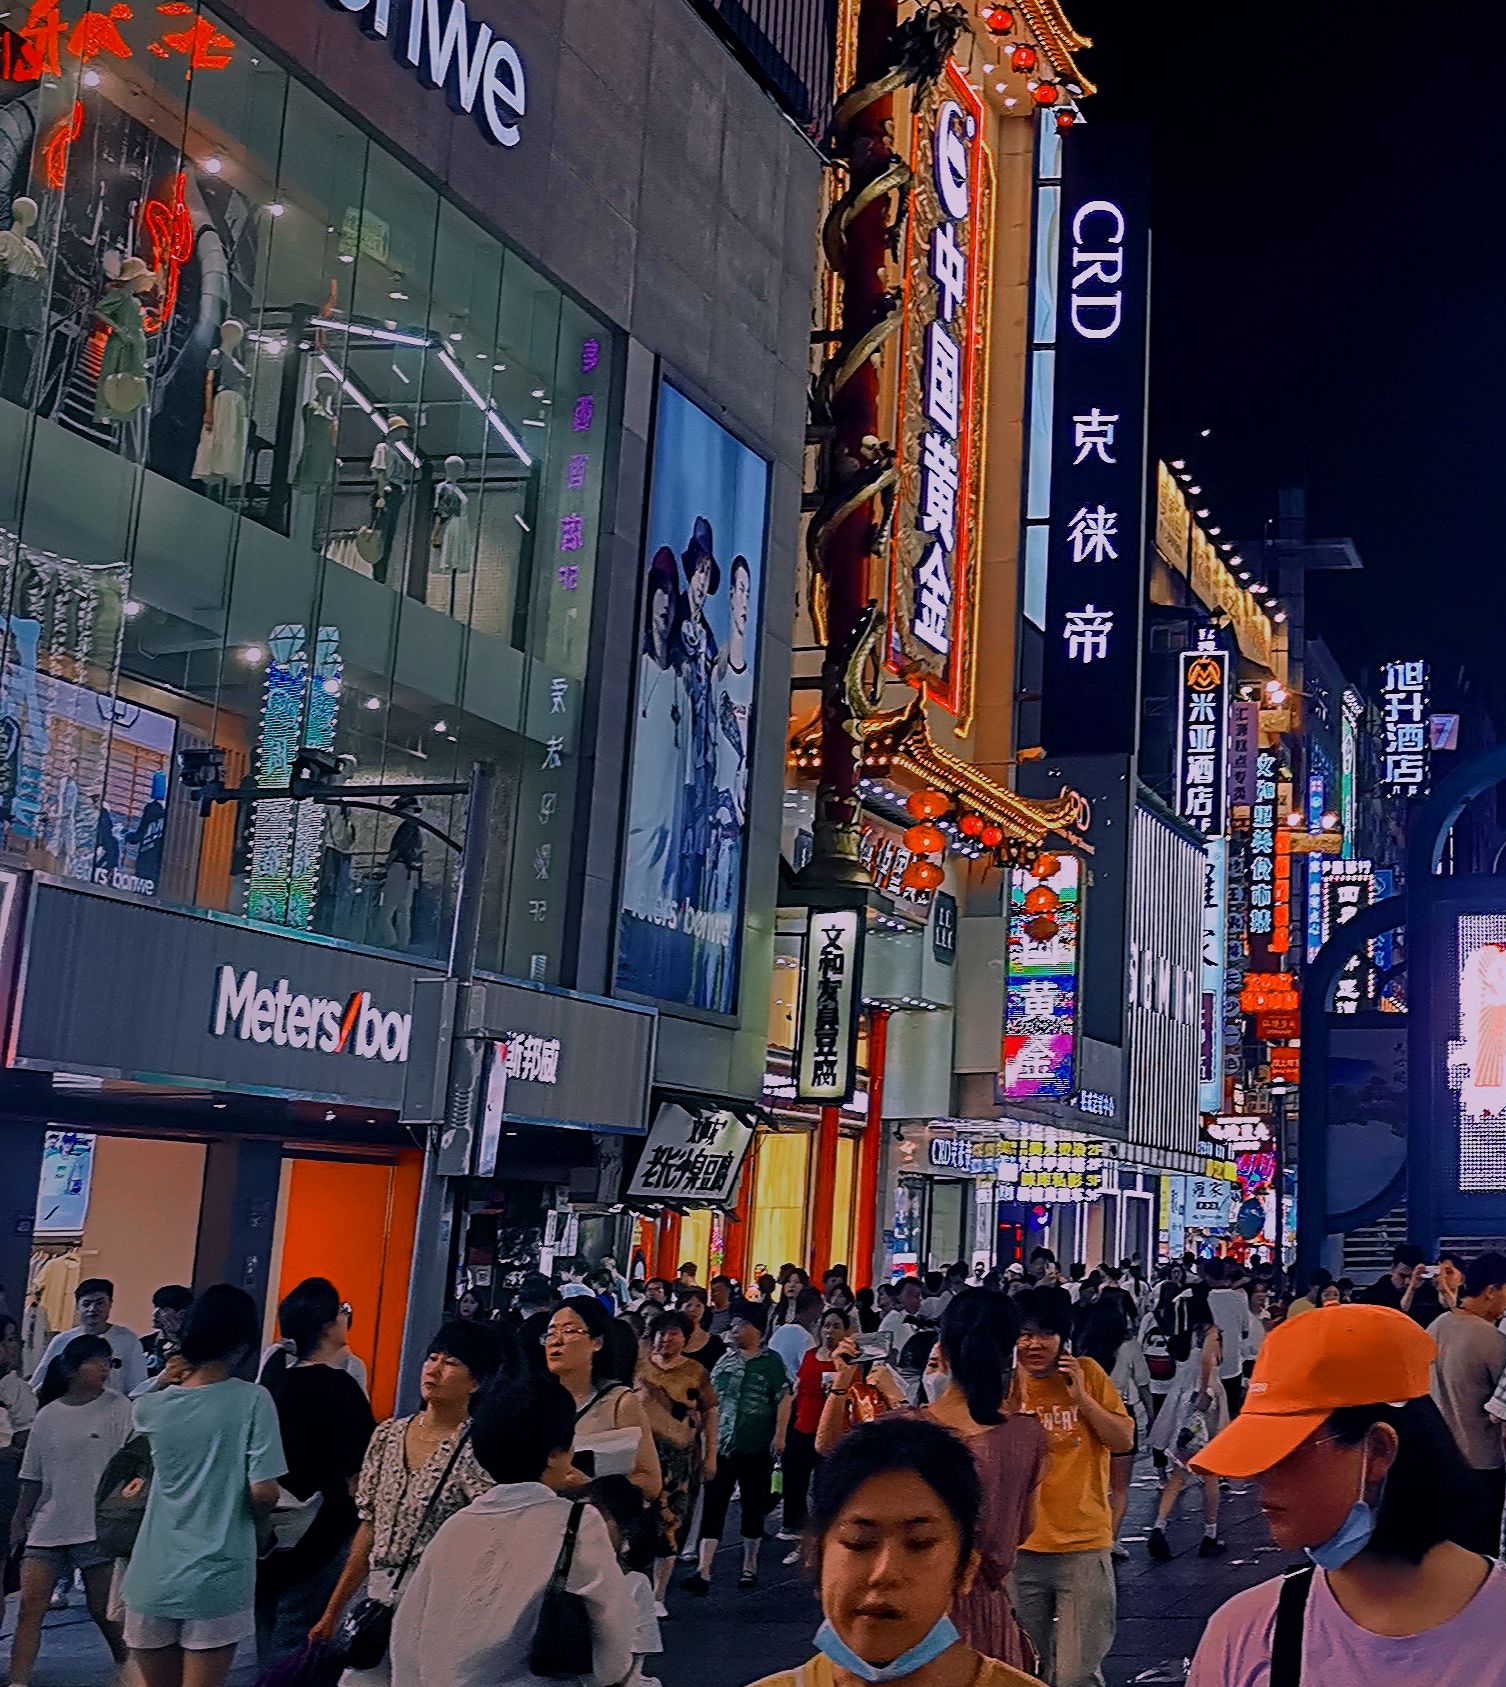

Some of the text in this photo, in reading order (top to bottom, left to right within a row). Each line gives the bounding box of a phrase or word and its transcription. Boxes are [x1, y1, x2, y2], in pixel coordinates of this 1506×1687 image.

[1071, 200, 1125, 339] CRD
[913, 222, 967, 655] 中国黄金
[1063, 407, 1120, 664] 克徕帝
[1185, 693, 1217, 816] 米亚酒店
[1385, 662, 1424, 782] 旭升酒店
